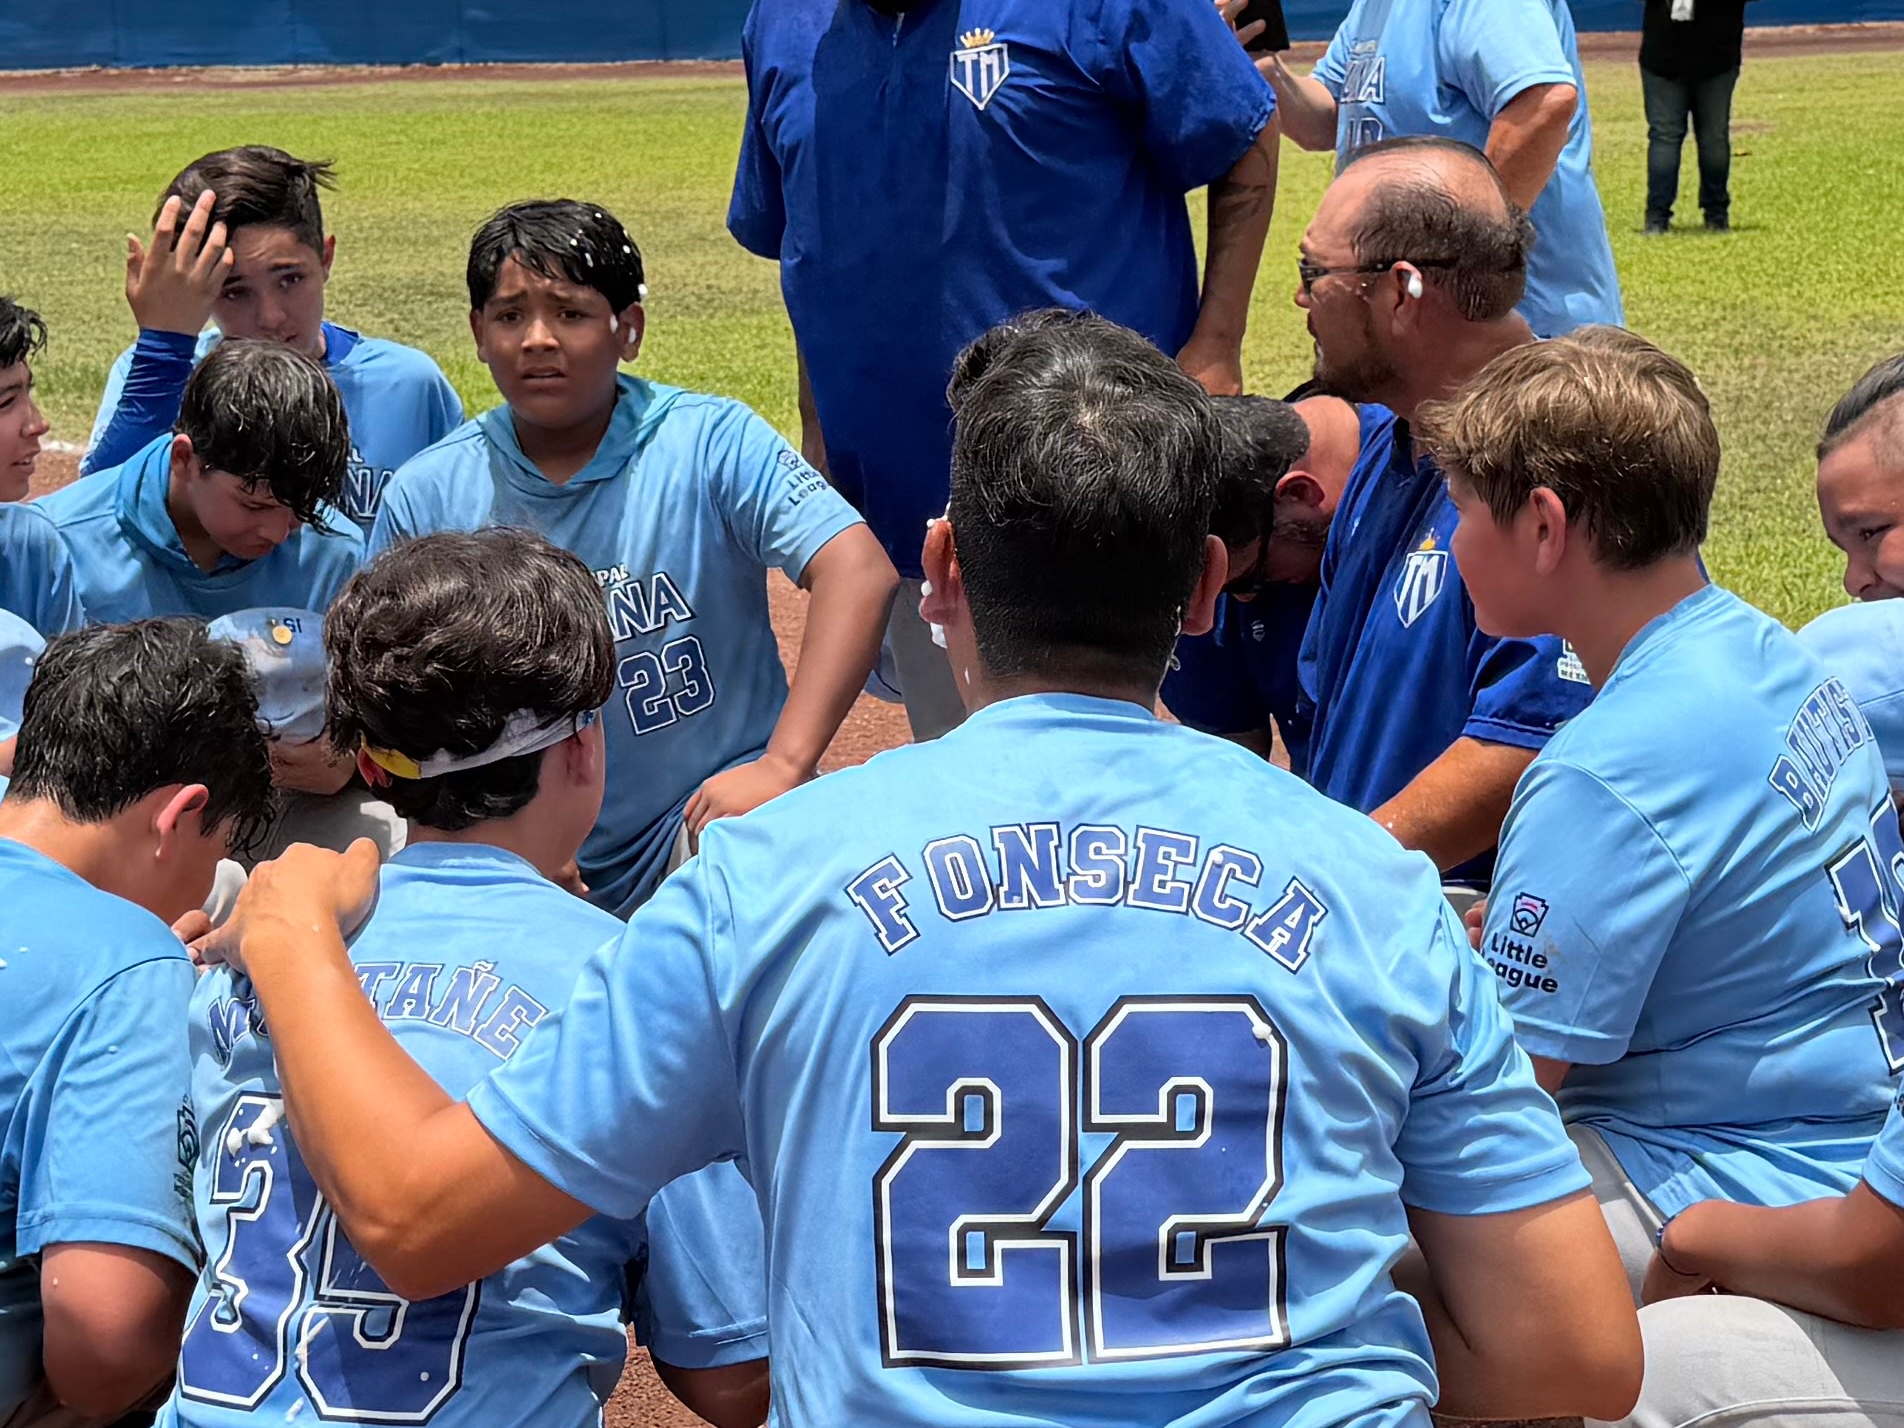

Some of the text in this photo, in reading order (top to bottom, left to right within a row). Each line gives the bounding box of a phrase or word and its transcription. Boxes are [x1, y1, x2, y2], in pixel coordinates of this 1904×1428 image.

[957, 52, 1000, 98] TM
[608, 571, 696, 642] NA
[1399, 555, 1442, 625] TM
[617, 635, 716, 736] 23
[1769, 676, 1874, 833] BAUTIS
[845, 821, 1329, 974] FONSECA
[1491, 933, 1549, 970] Little
[871, 994, 1293, 1370] 22
